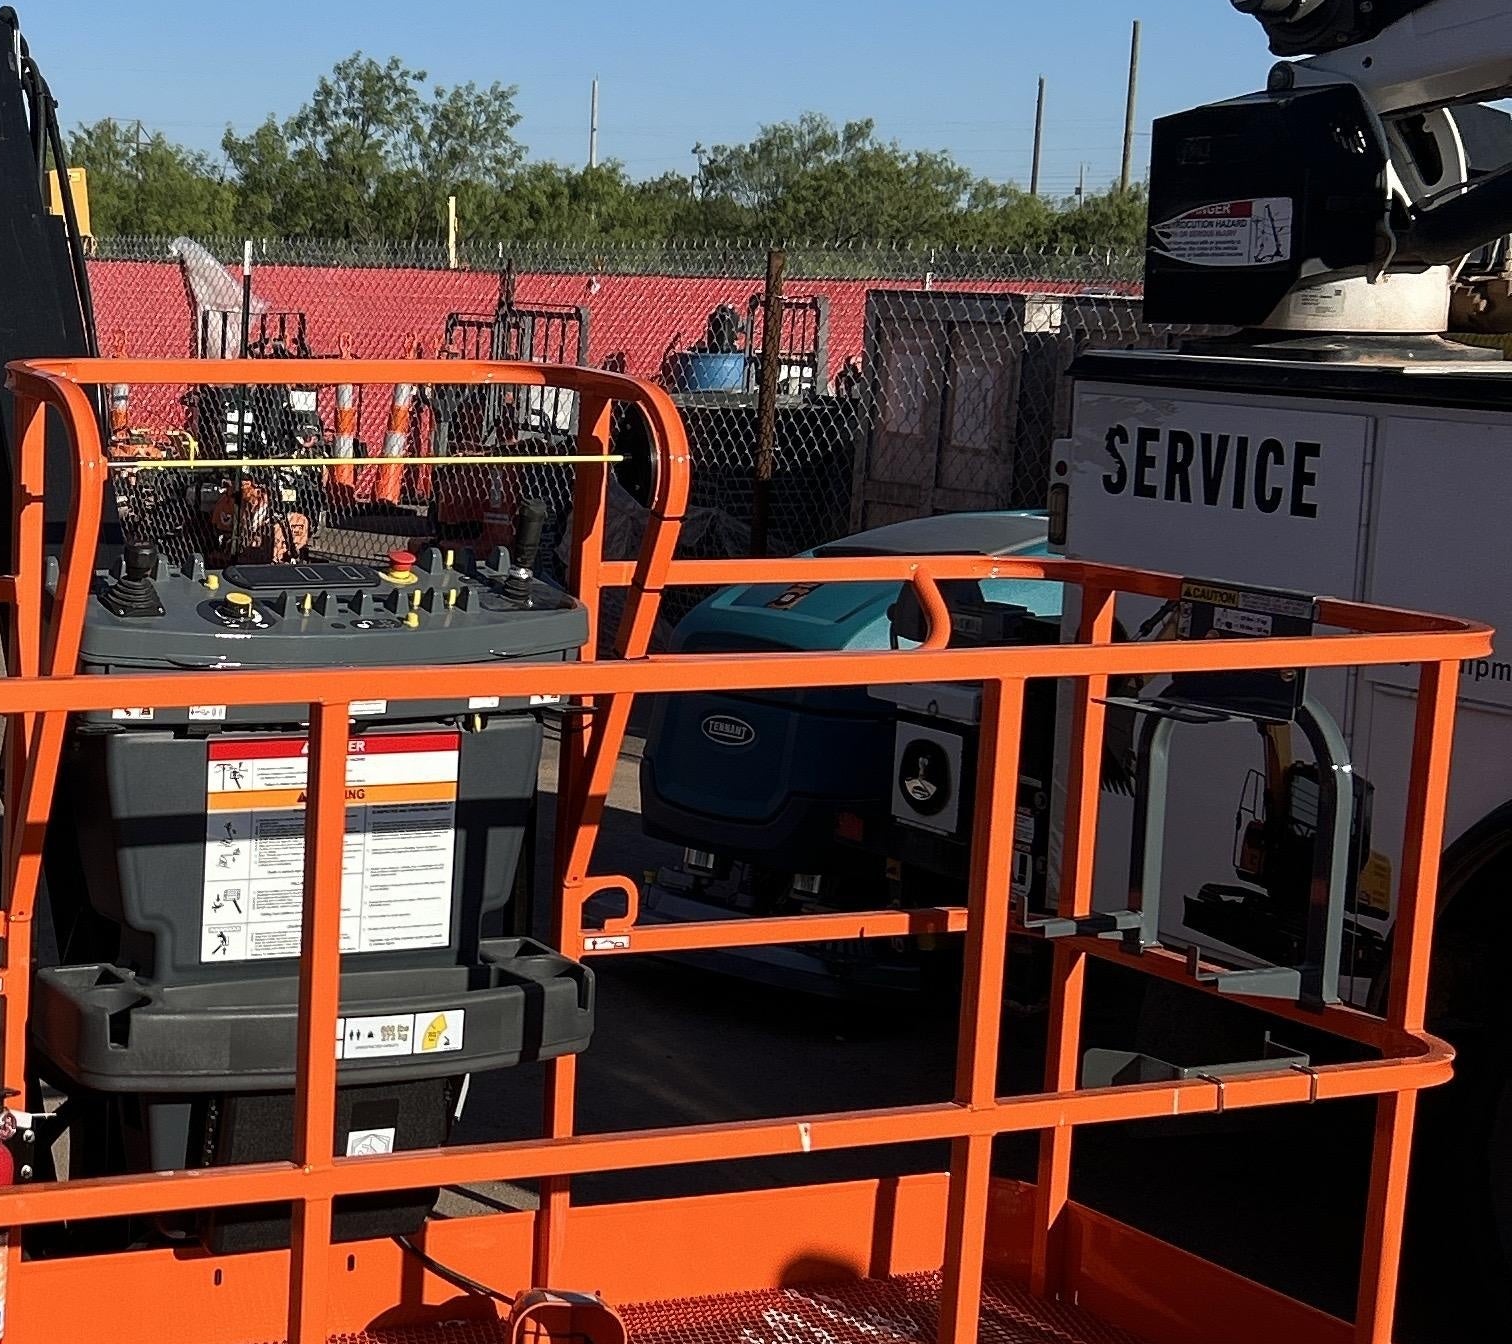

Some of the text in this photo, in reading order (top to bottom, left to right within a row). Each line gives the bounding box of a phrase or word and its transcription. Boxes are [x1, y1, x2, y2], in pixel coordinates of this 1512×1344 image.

[1102, 425, 1321, 519] SERVICE
[1192, 585, 1236, 605] CAUTION
[709, 720, 747, 739] TENNANT
